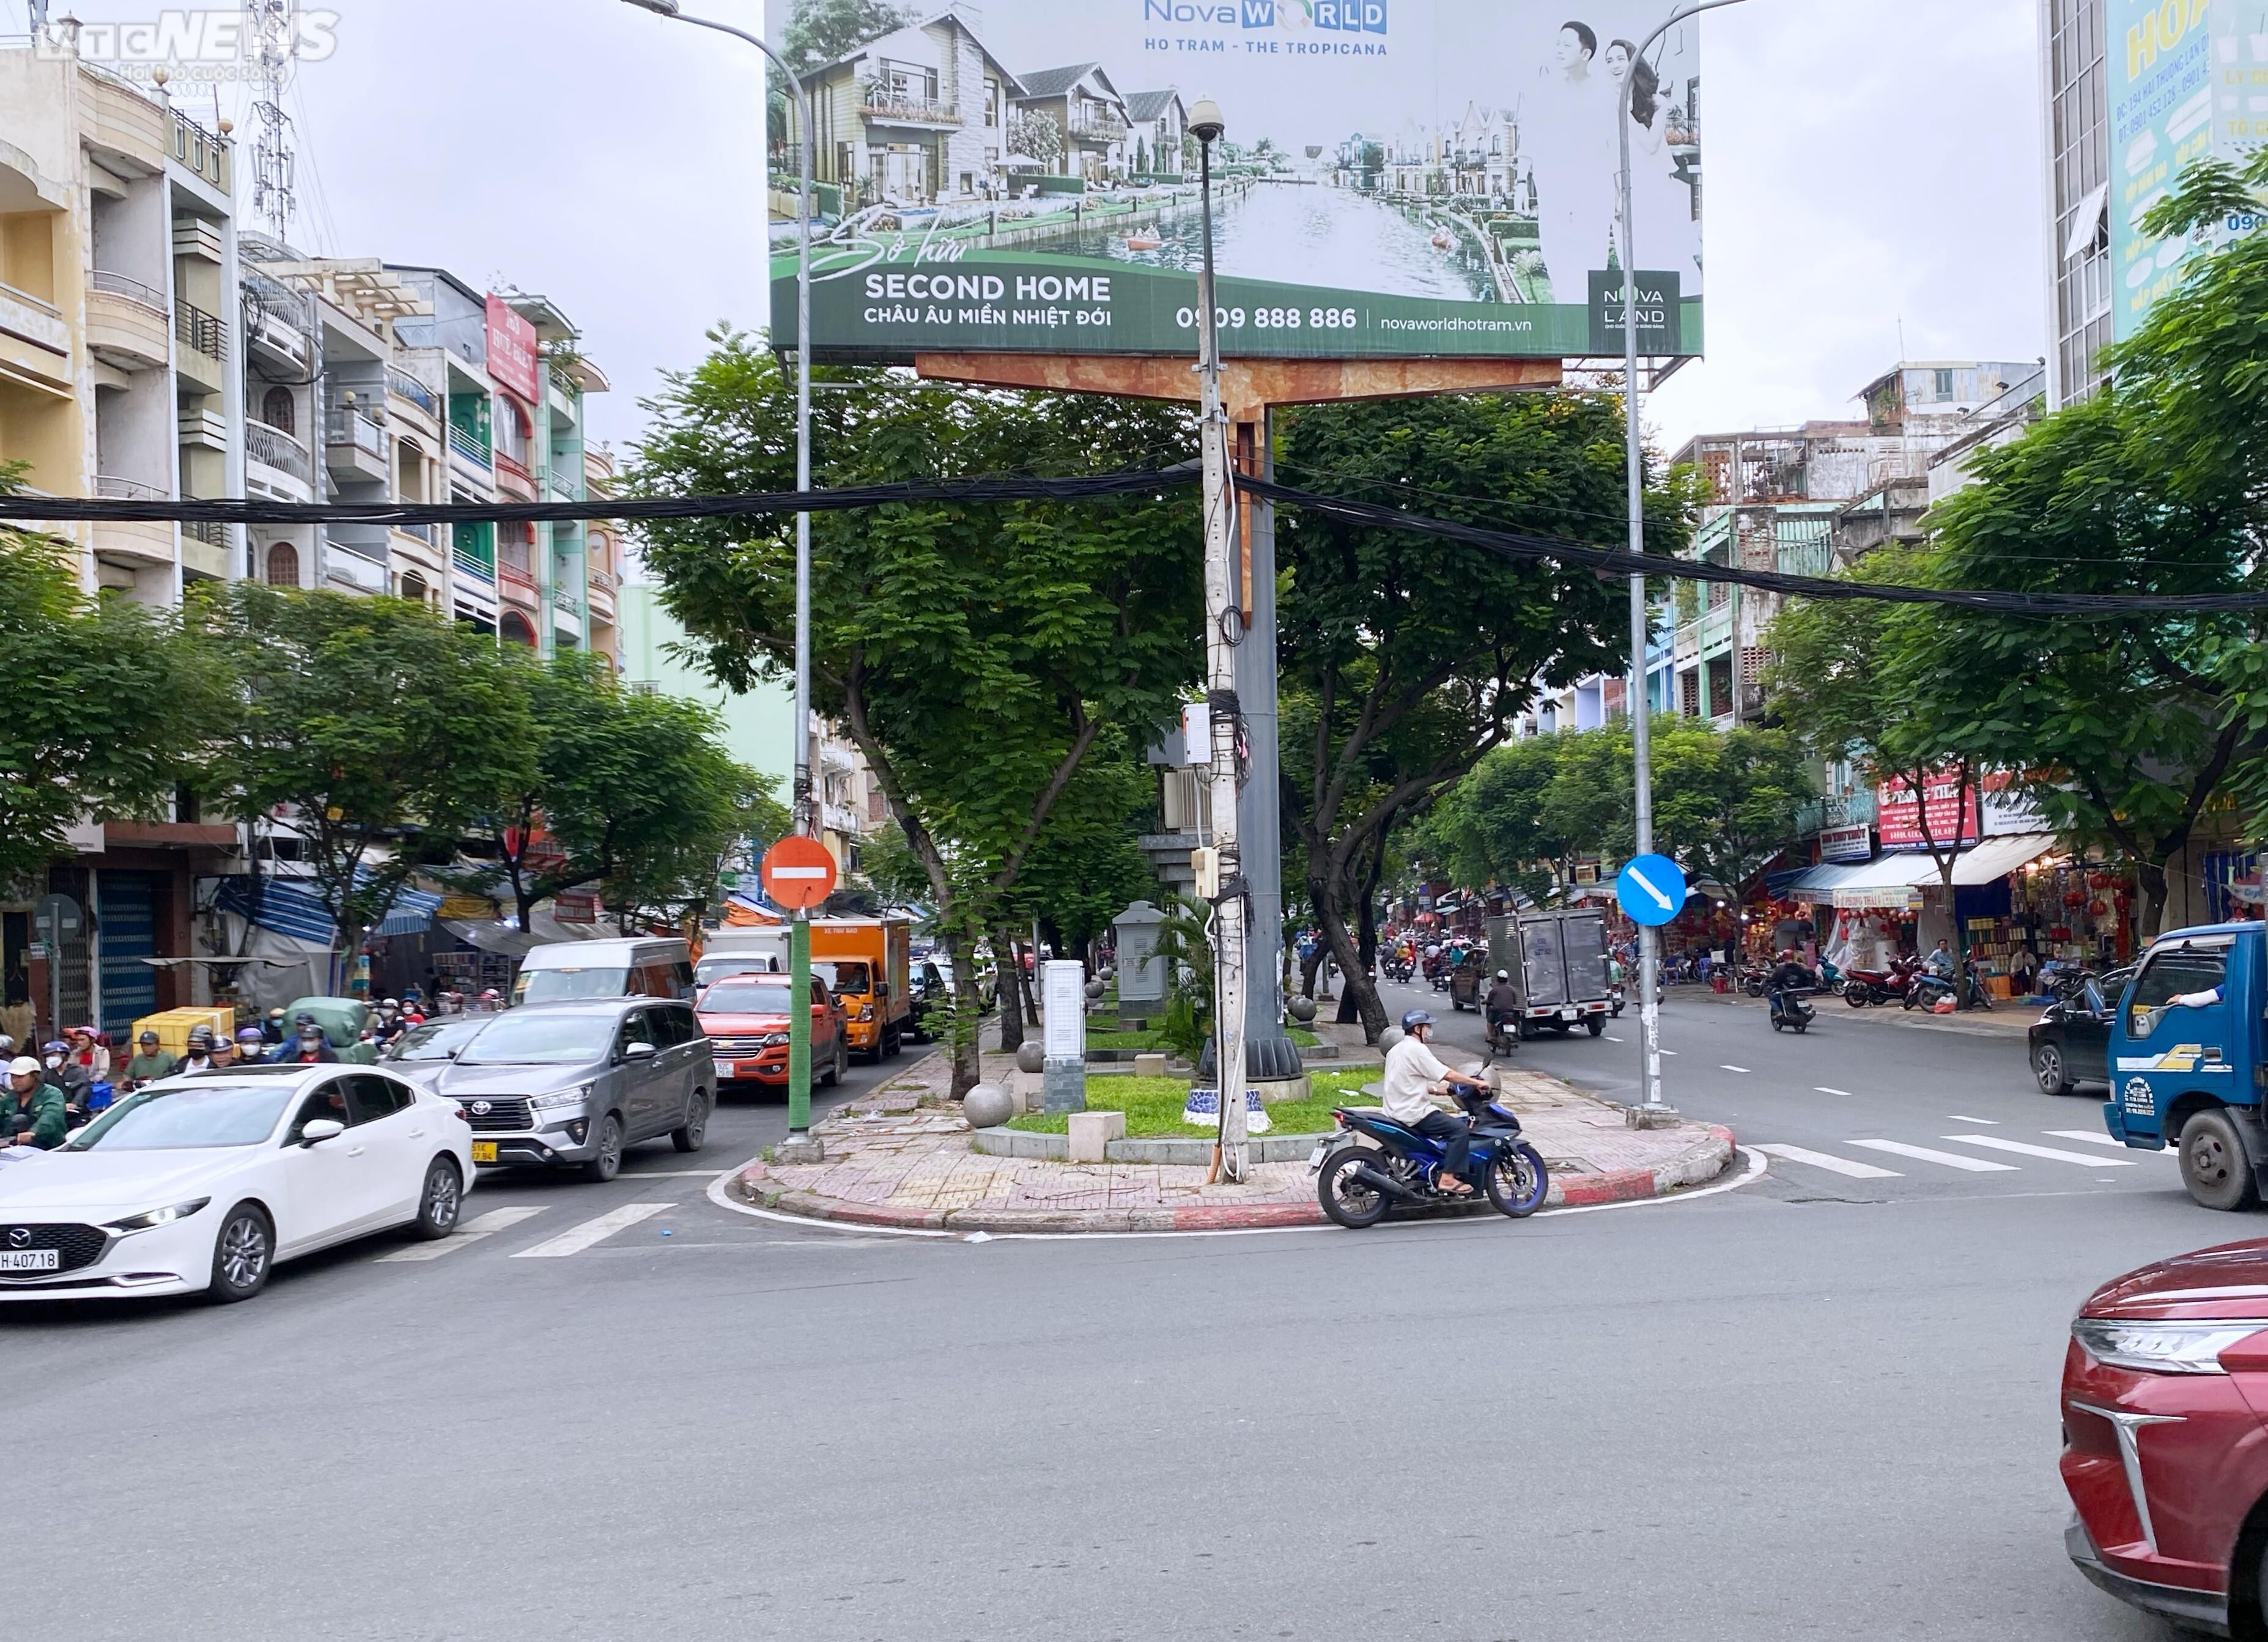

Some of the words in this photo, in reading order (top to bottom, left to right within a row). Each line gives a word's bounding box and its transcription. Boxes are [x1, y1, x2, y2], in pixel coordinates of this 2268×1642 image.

[1145, 39, 1169, 50] HO
[1176, 40, 1224, 51] TRAM
[1246, 42, 1278, 53] THE
[1286, 42, 1387, 55] TROPICANA
[797, 204, 911, 282] Sở
[865, 273, 1005, 300] SECOND
[1016, 275, 1111, 301] HOME
[863, 304, 919, 323] CHÂU
[924, 304, 952, 324] ÂU
[958, 303, 1006, 325] MIỀN
[1013, 306, 1070, 328] NHIỆT
[1075, 307, 1111, 326] ĐỚI
[1176, 307, 1246, 328] 009
[1254, 307, 1301, 328] 888
[1309, 307, 1357, 328] 886
[1381, 317, 1532, 331] novaworldhotram.vn
